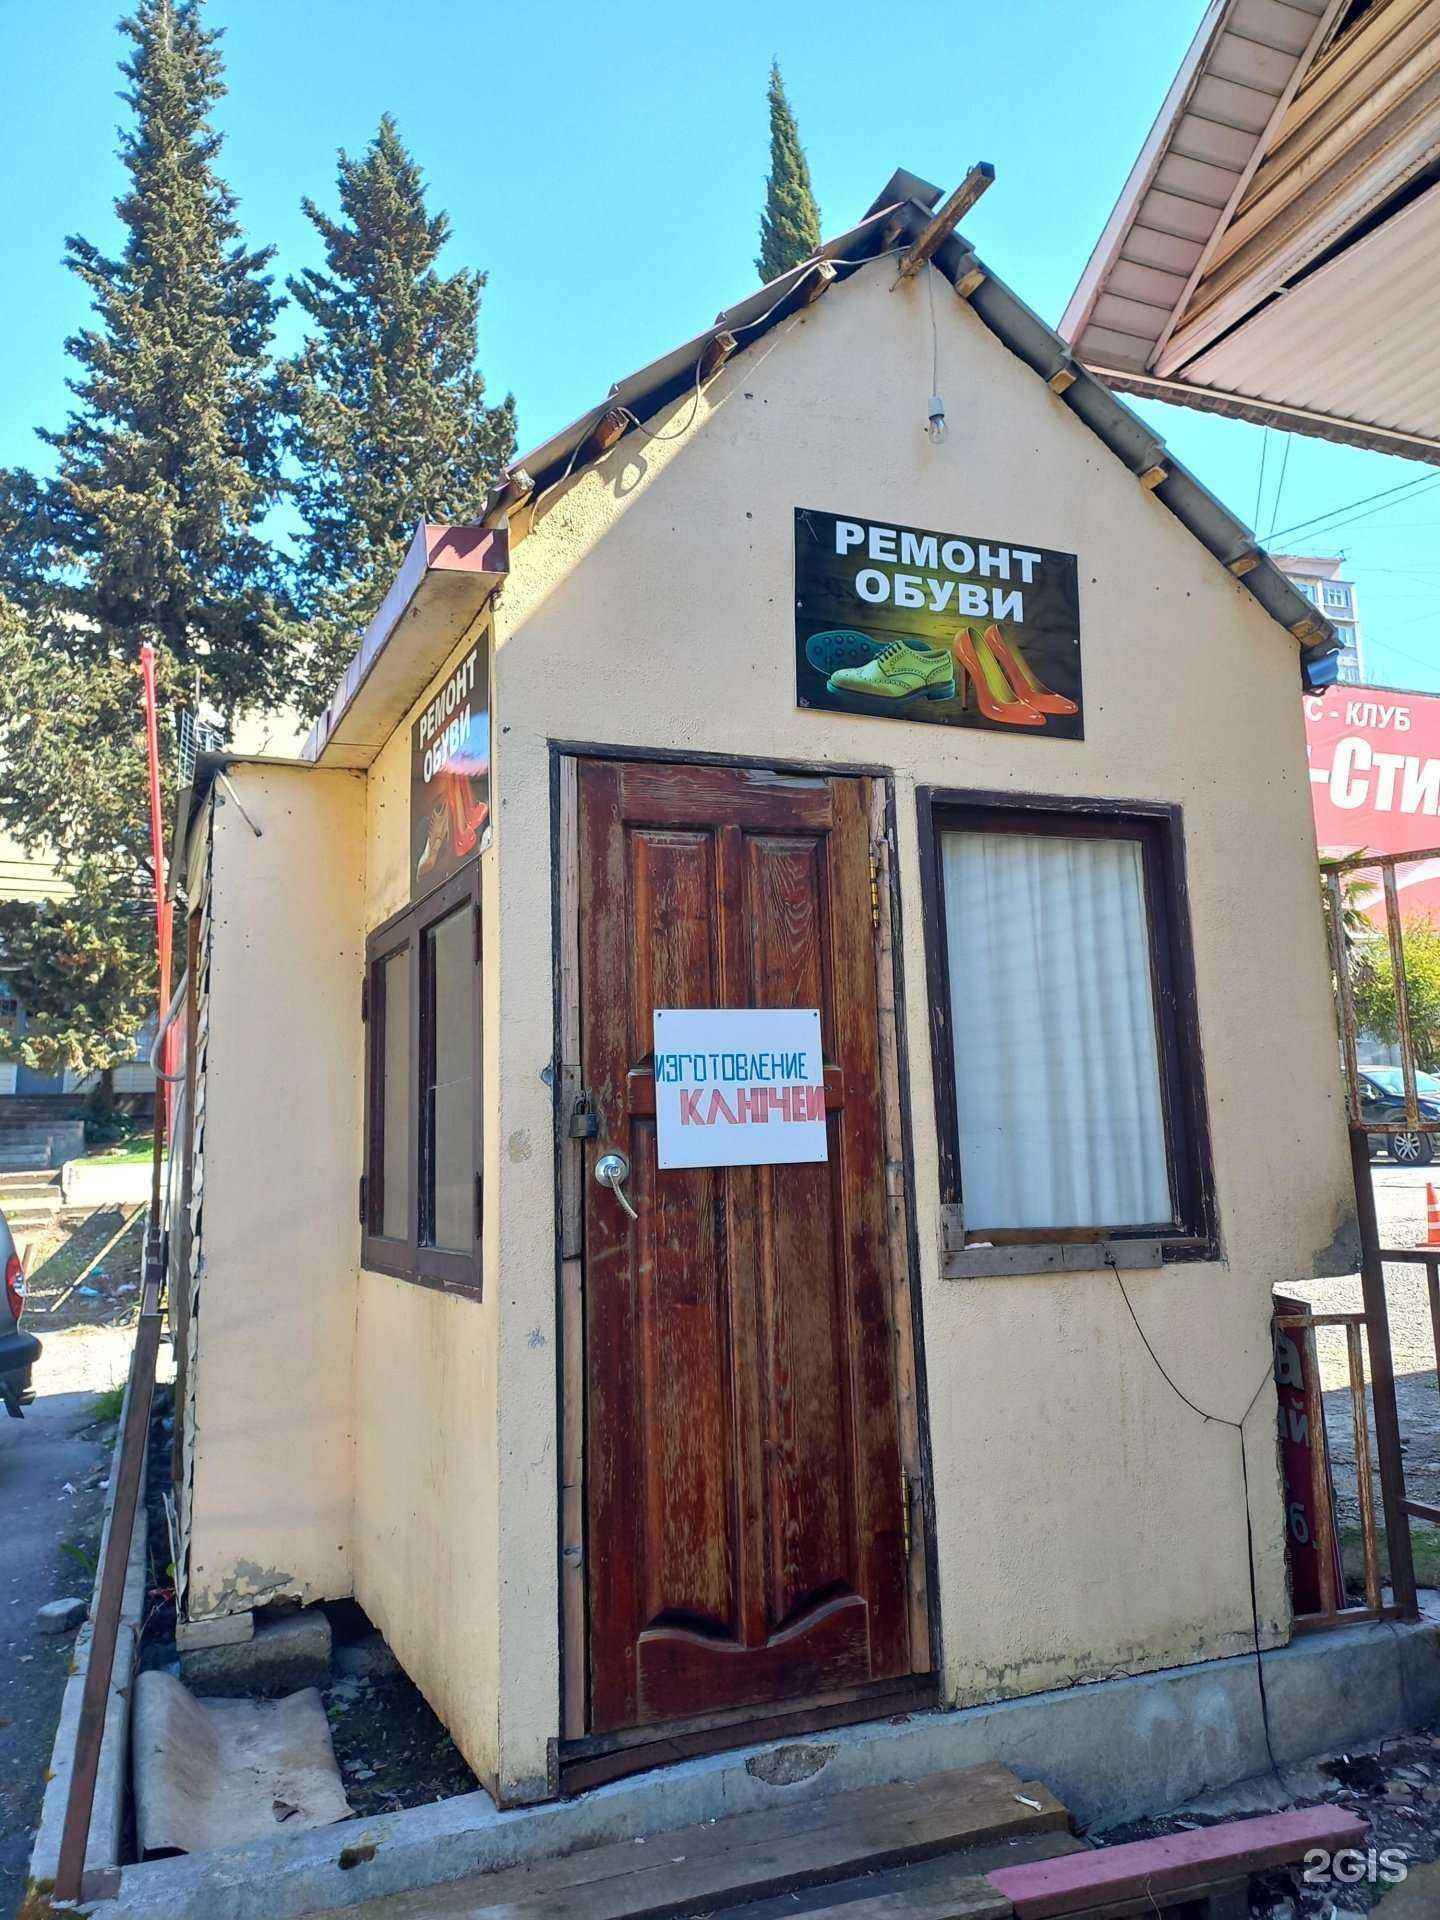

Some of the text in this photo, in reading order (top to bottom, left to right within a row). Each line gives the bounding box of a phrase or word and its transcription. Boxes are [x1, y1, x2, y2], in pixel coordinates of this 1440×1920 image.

[835, 520, 1042, 584] РЕМОНТ
[854, 568, 1024, 623] ОБУВИ
[419, 648, 477, 750] РЕМОНТ
[1345, 701, 1411, 732] КЛУБ
[423, 703, 471, 784] ОБУВИ
[655, 1052, 809, 1083] ИЗГОТОВЛЕНИЕ
